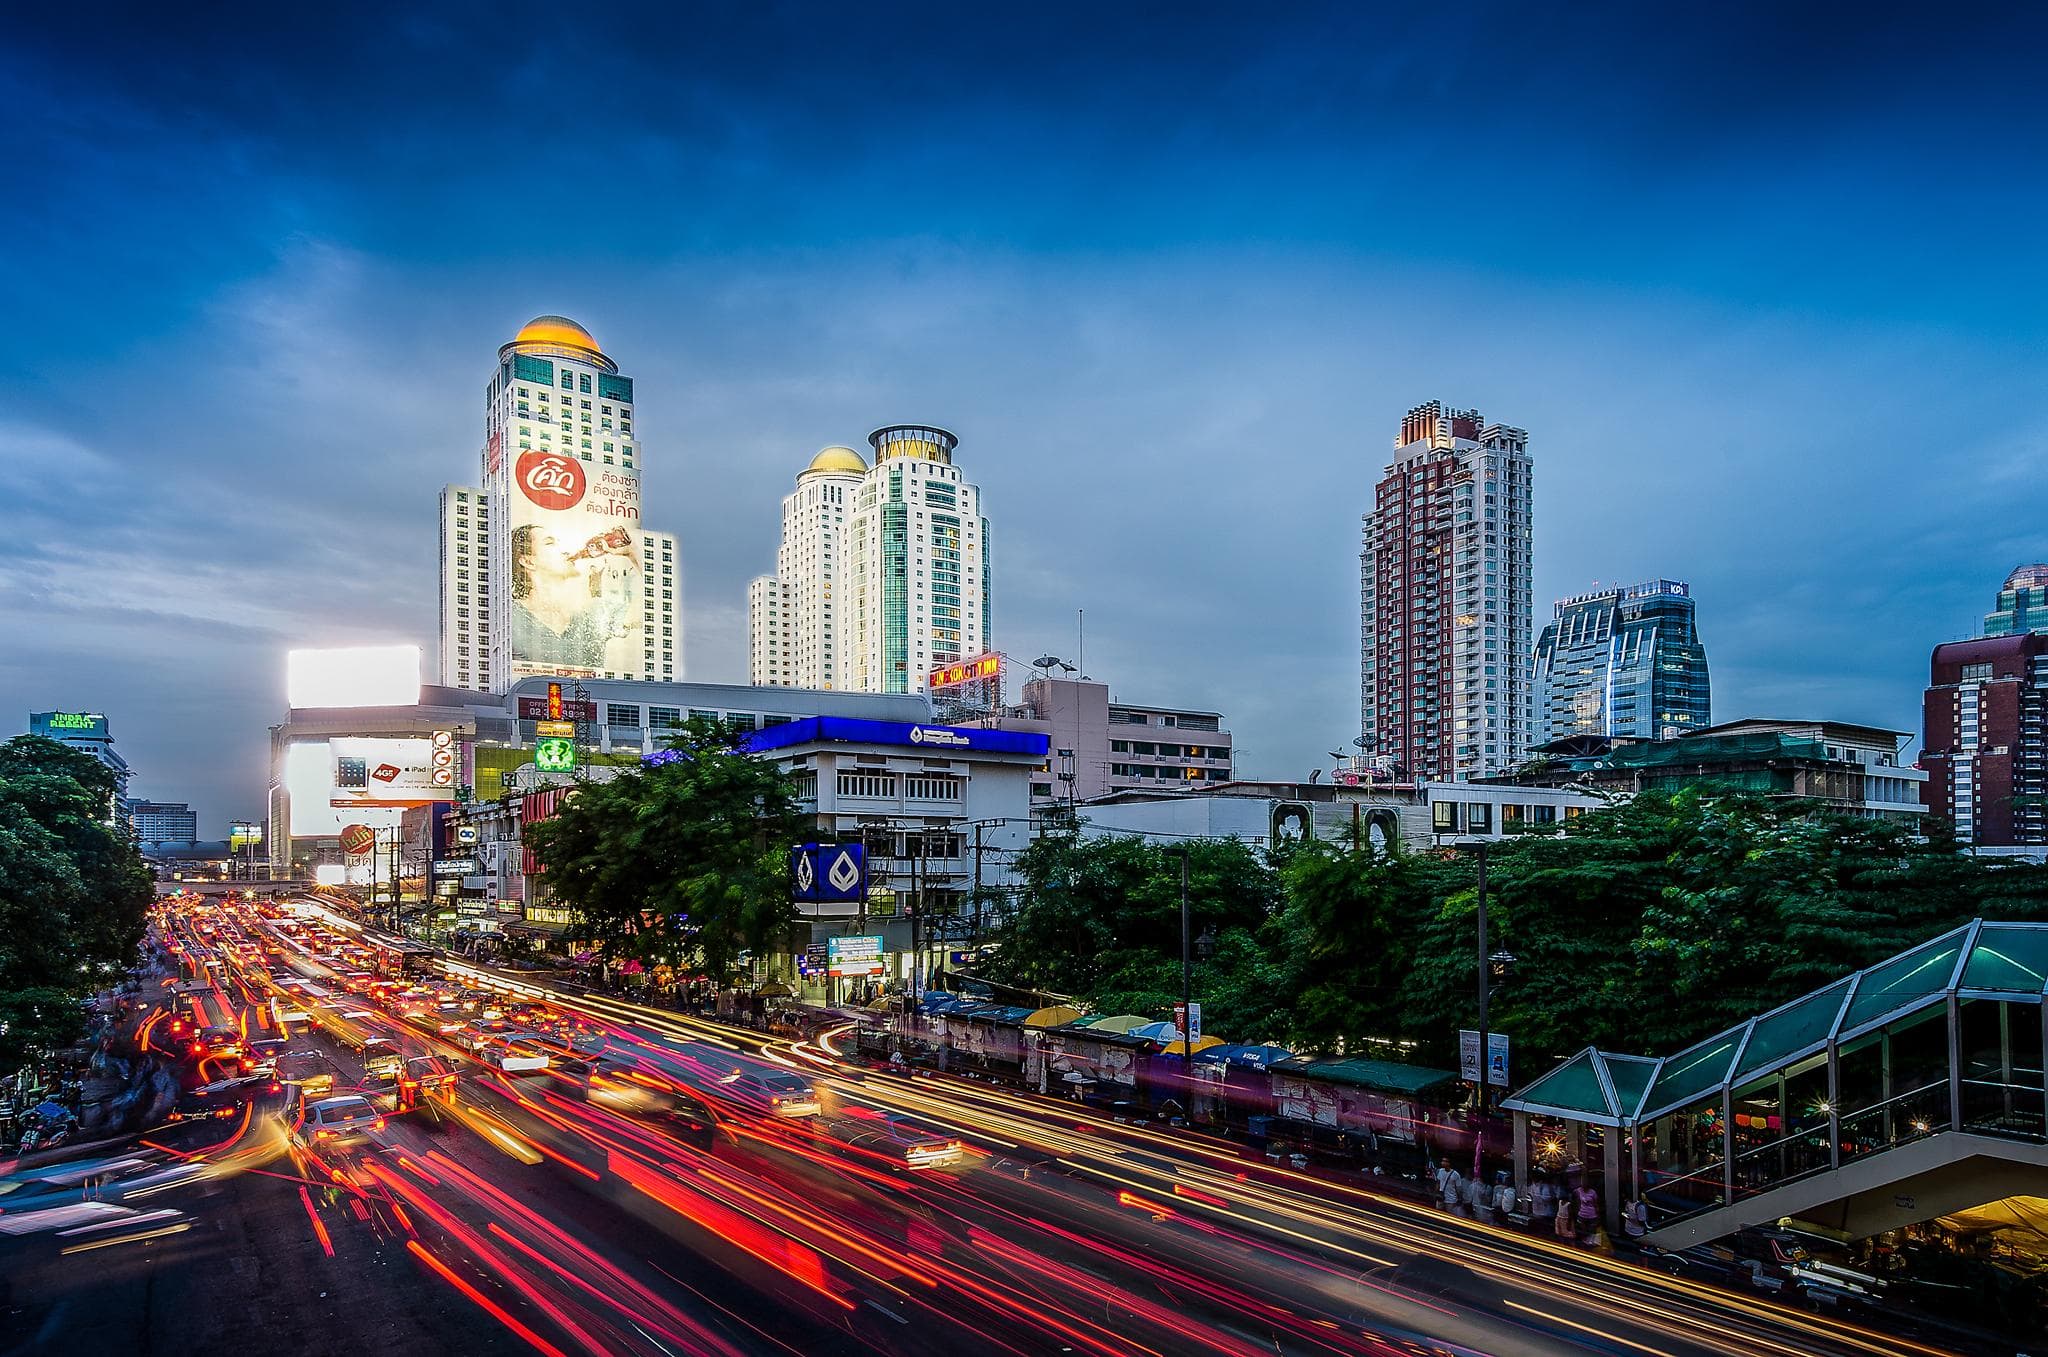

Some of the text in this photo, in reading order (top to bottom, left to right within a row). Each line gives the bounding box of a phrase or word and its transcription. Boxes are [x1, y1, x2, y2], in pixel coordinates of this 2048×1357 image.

[601, 470, 638, 488] ต้องซ่า
[593, 482, 638, 501] ต้องกล้า
[586, 499, 639, 520] ต้องโค้ก
[983, 657, 998, 675] INN
[54, 713, 91, 722] INDRA
